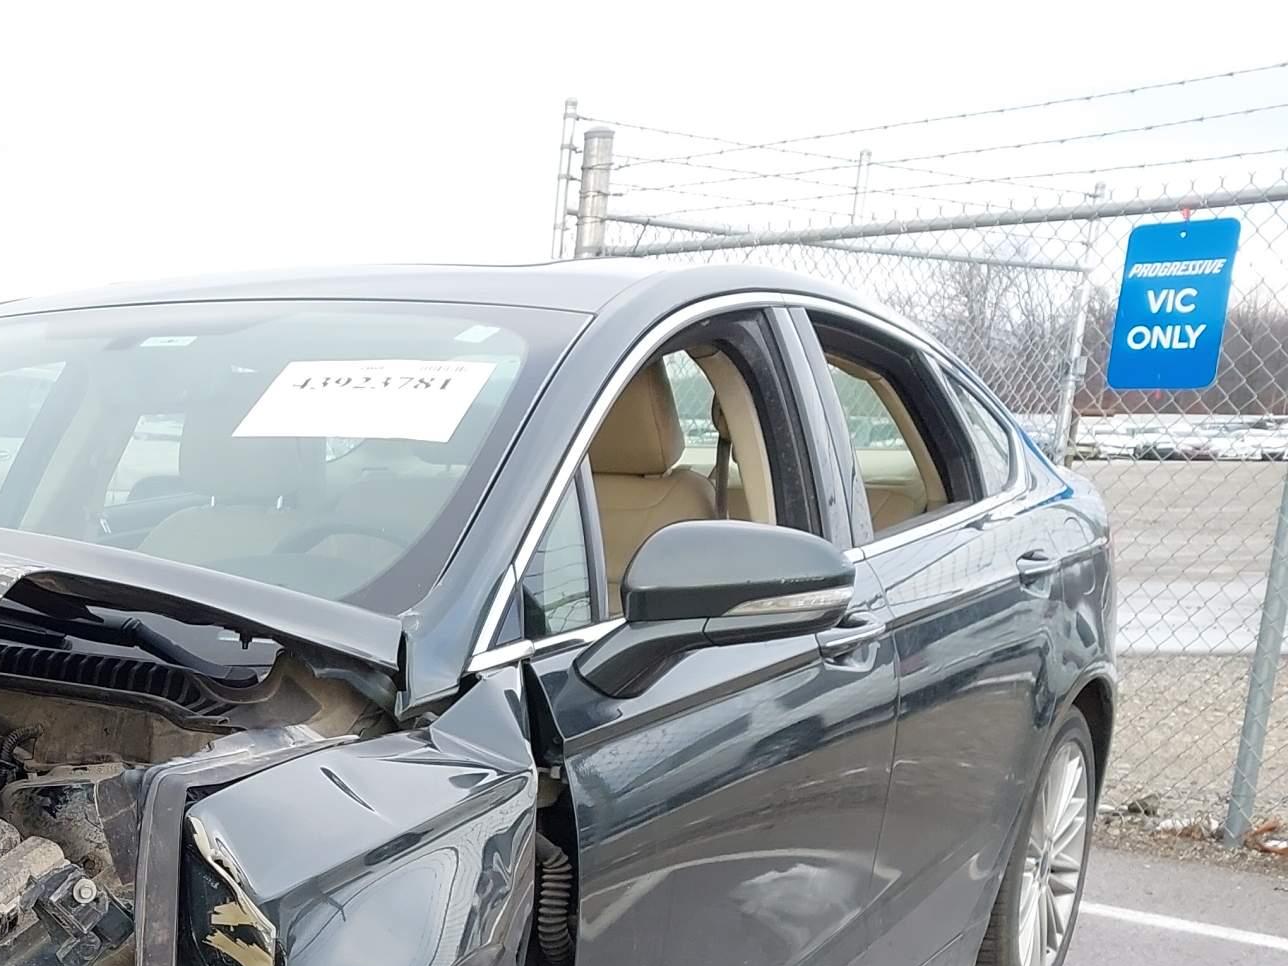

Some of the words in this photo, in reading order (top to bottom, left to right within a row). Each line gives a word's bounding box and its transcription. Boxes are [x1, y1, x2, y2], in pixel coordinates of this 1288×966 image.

[1128, 258, 1227, 279] PROGRESSIVE
[1147, 287, 1198, 314] VIC
[1127, 324, 1207, 350] ONLY
